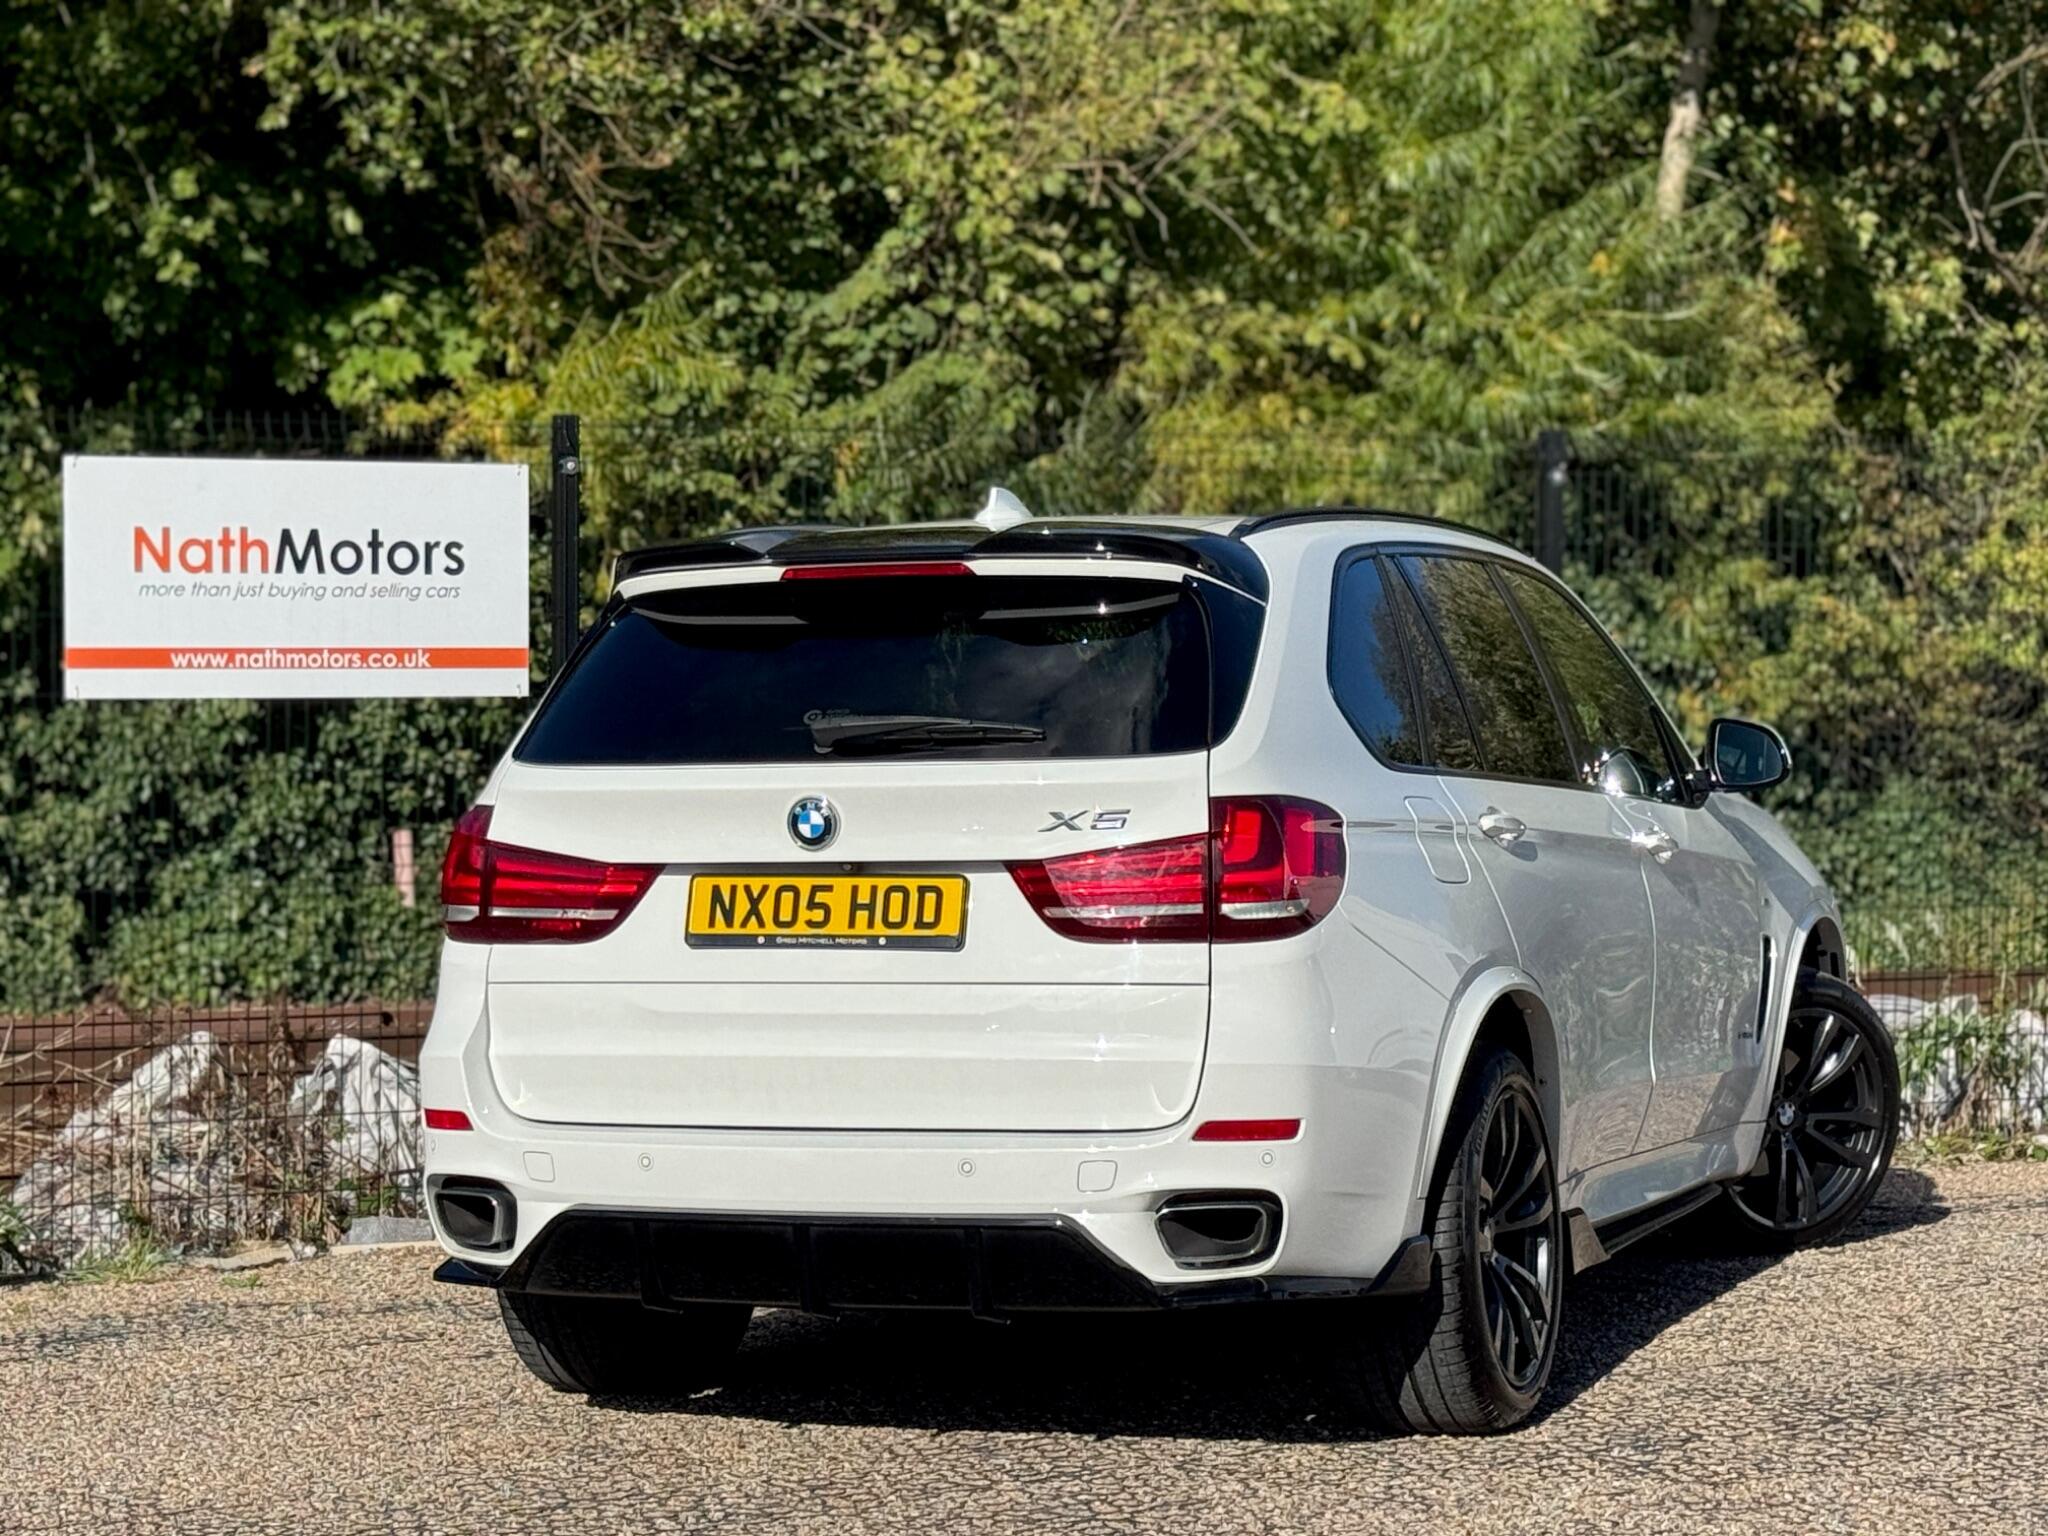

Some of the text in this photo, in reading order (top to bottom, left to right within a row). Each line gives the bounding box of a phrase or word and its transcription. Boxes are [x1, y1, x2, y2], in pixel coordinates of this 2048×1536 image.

[138, 581, 461, 601] more than just buying and selling cars
[170, 650, 431, 669] www.nathmotors.co.uk
[1037, 808, 1131, 832] X5
[708, 884, 944, 930] NX05 HOD
